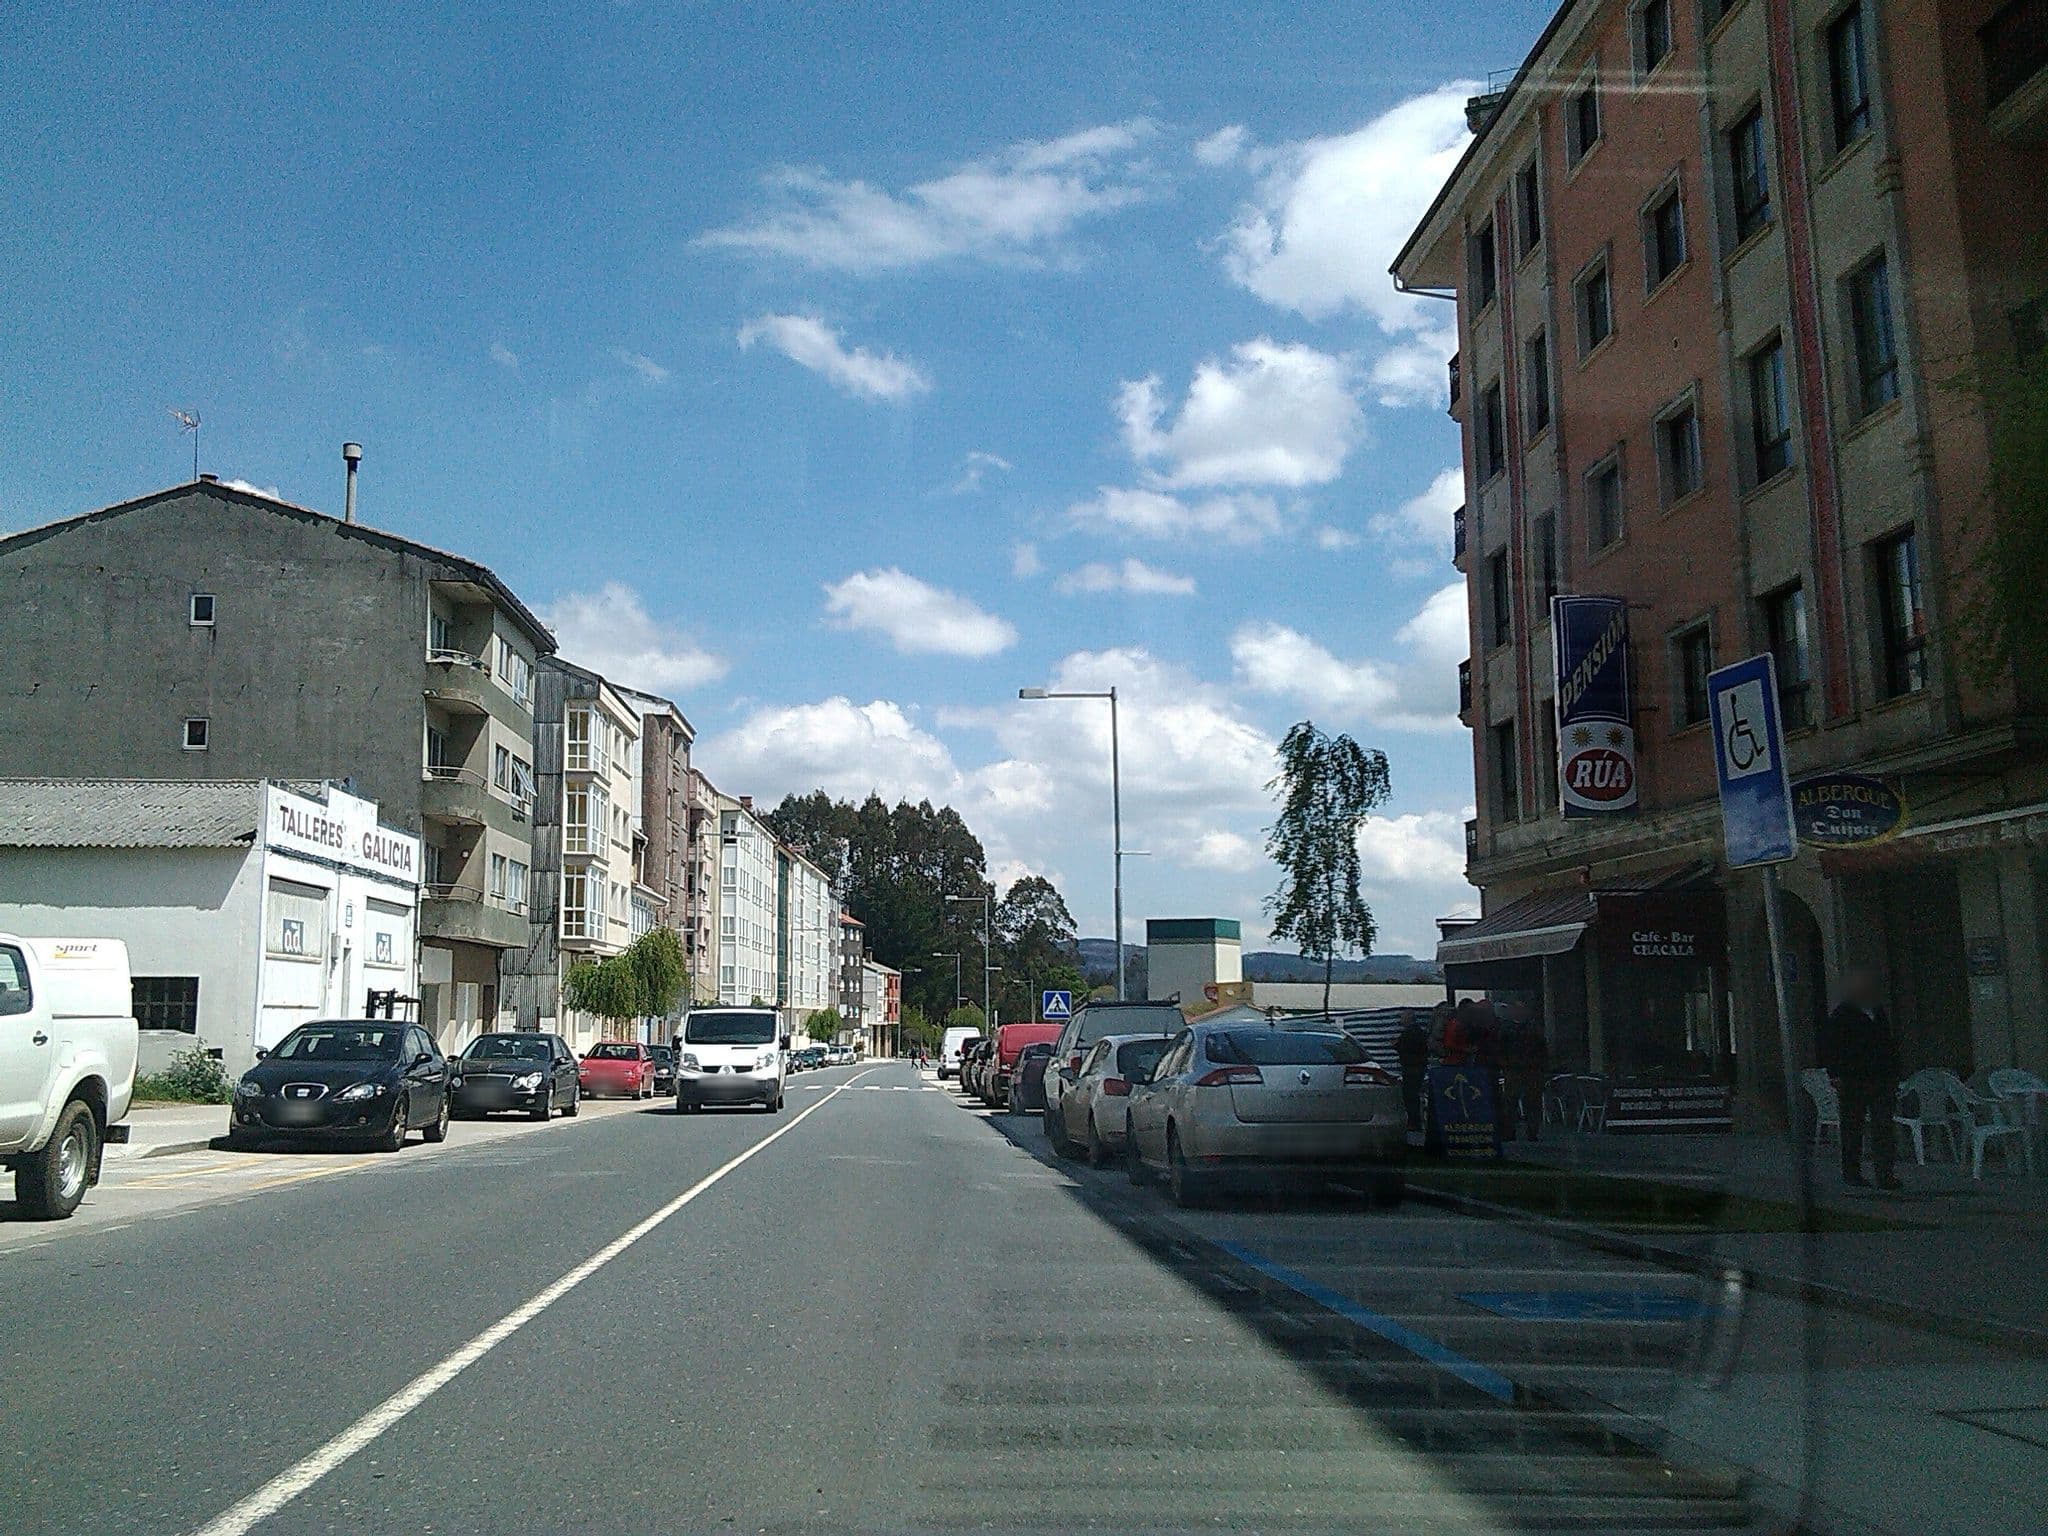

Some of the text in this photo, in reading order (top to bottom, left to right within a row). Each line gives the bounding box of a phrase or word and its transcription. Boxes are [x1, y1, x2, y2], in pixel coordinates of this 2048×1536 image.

[1573, 751, 1627, 789] RÚA
[1798, 784, 1891, 810] ALBERGUE
[1825, 805, 1862, 819] Don
[279, 805, 412, 872] TALLERES GALICIA
[1671, 931, 1695, 943] Bar
[55, 944, 98, 954] sport
